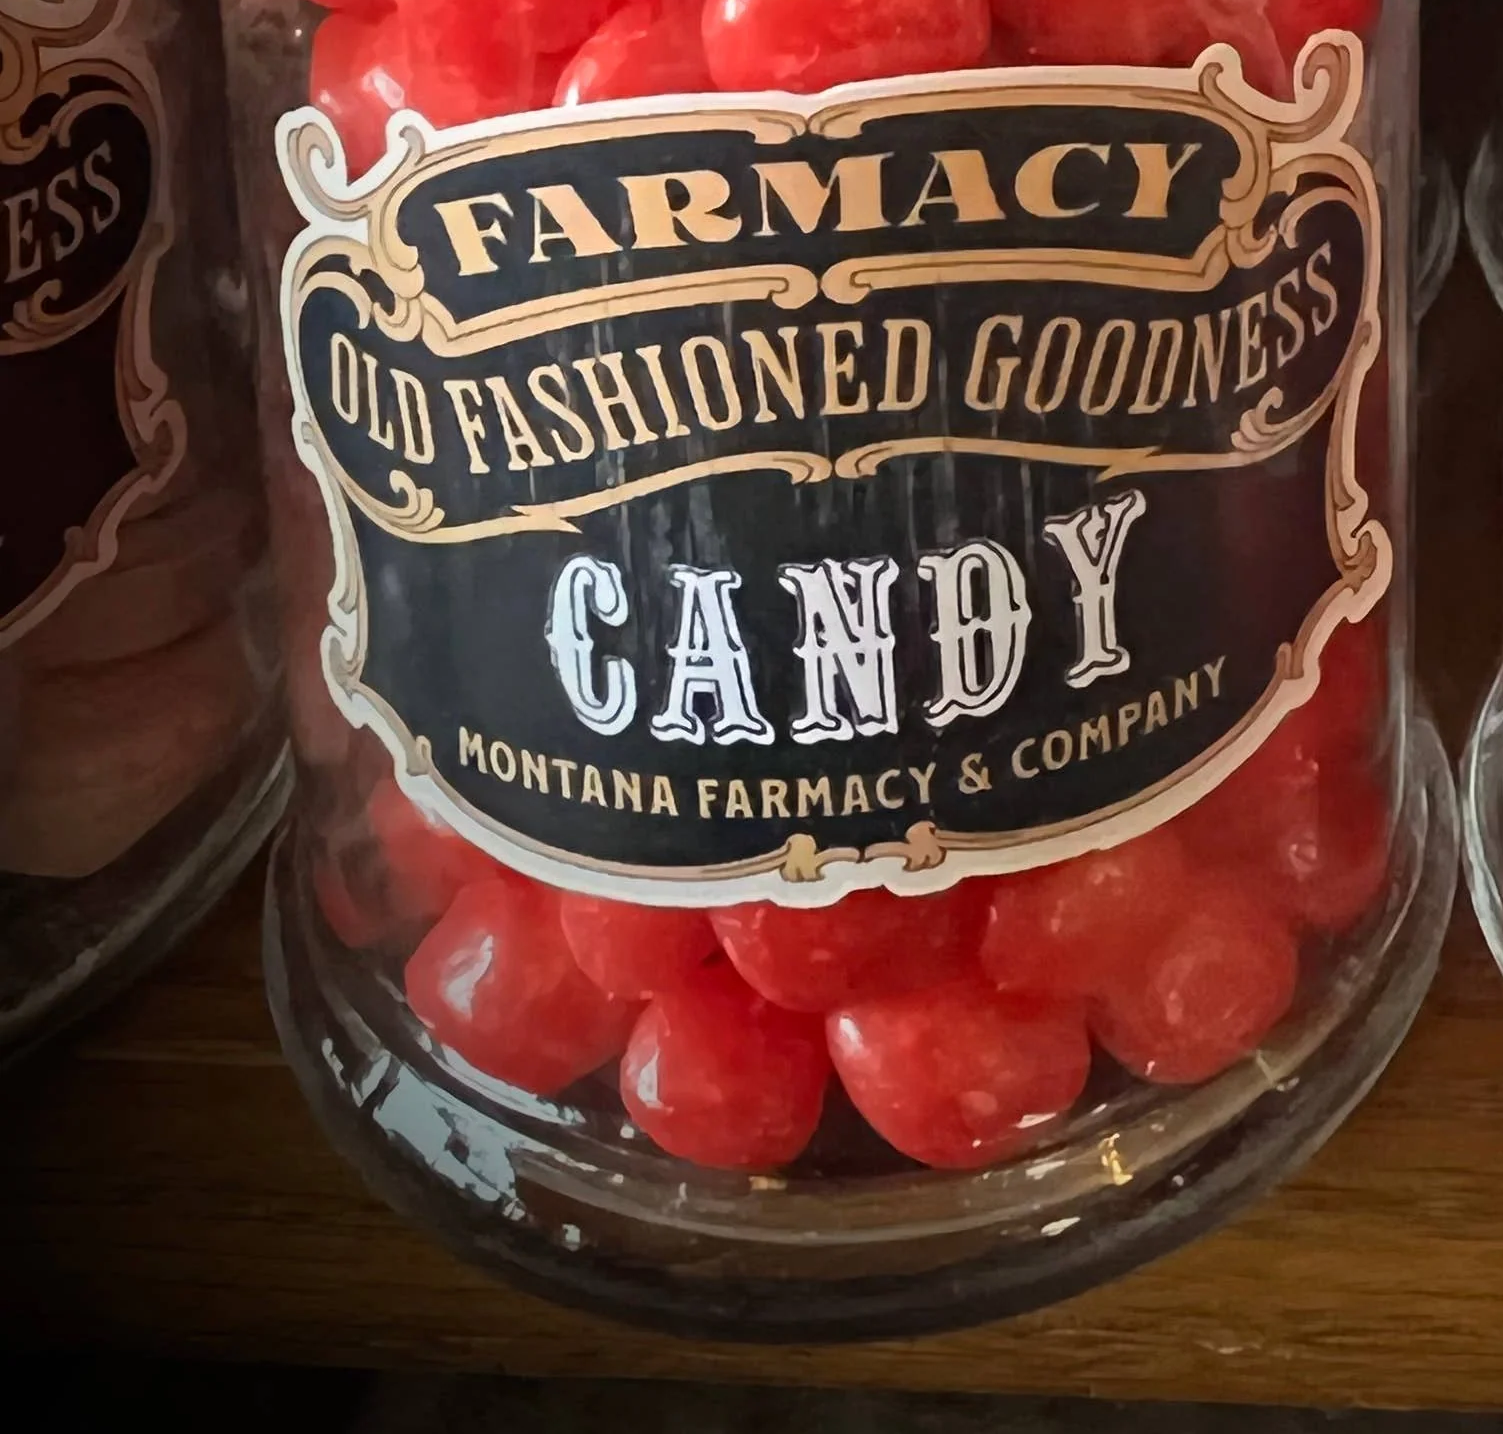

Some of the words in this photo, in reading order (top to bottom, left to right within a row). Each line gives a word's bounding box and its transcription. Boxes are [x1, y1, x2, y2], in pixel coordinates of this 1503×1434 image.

[2, 139, 121, 284] ESS
[432, 142, 1203, 277] FARMACY
[329, 332, 435, 465] OLD
[442, 318, 932, 474] FASHIONED
[964, 241, 1337, 415] GOODNESS
[544, 489, 1147, 746] CANDY
[457, 726, 680, 818] MONTANA
[697, 763, 936, 820] FARMACY
[957, 752, 992, 793] &
[1010, 655, 1227, 780] COMPANY
